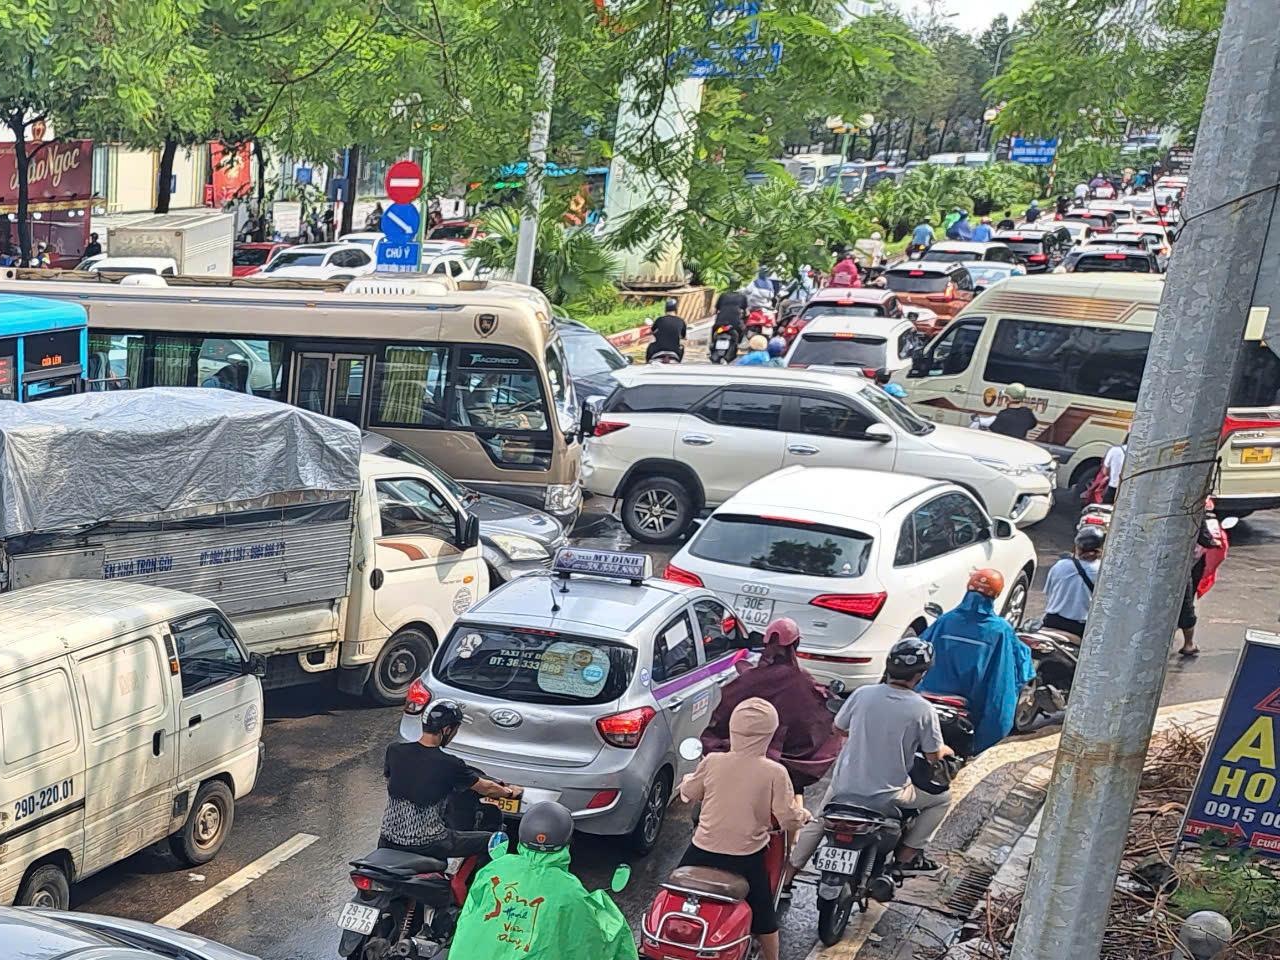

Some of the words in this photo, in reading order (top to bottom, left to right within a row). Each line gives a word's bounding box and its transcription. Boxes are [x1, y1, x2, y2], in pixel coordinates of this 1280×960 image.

[735, 607, 769, 624] 14.02
[15, 778, 74, 821] 29D-220.01
[1211, 766, 1280, 804] HO
[1204, 800, 1257, 823] 0915
